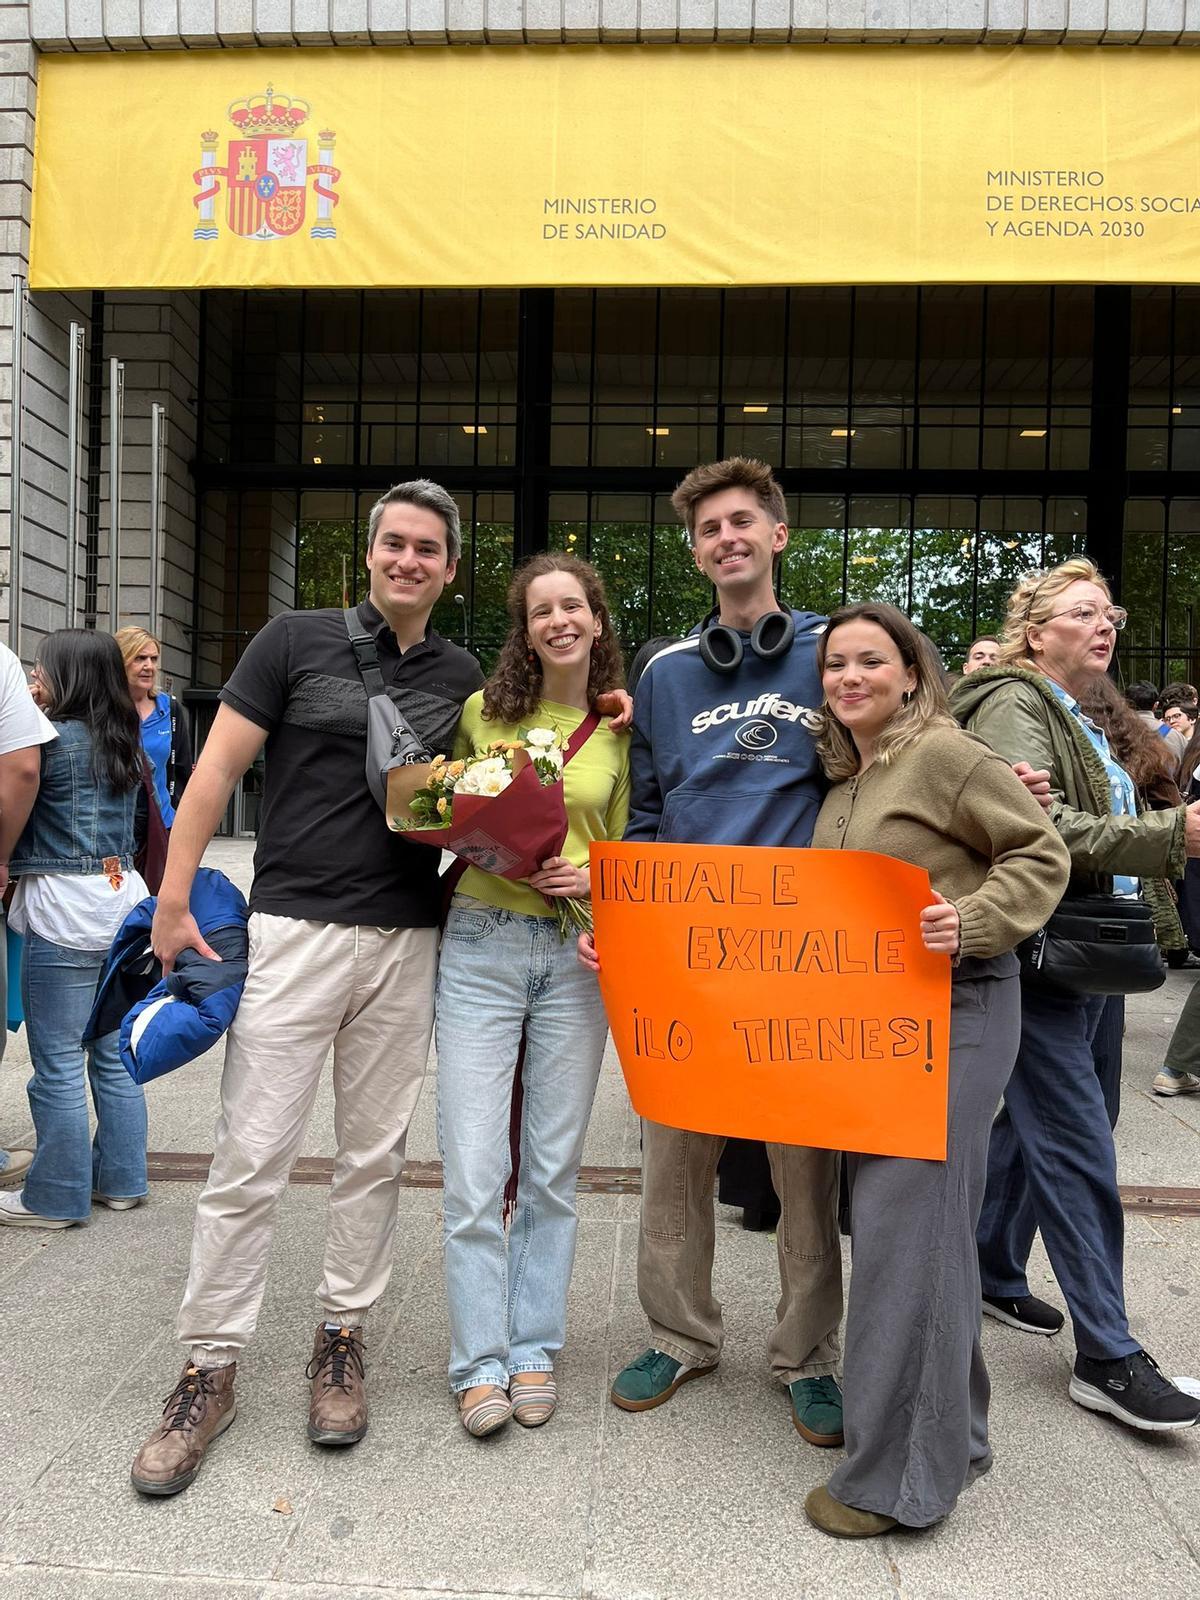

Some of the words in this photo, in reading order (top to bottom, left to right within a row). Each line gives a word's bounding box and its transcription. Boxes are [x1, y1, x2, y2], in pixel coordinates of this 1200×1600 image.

[987, 171, 1104, 187] MINISTERIO
[544, 198, 657, 214] MINISTERIO
[986, 195, 1014, 211] DE
[1021, 196, 1134, 212] DERECHOS
[1140, 196, 1200, 213] SOCIA
[543, 223, 569, 239] DE
[575, 223, 667, 239] SANIDAD
[986, 220, 999, 237] Y
[1003, 220, 1094, 237] AGENDA
[1100, 221, 1145, 237] 2030
[691, 692, 826, 734] scuffers
[600, 858, 799, 906] INHALE
[688, 926, 906, 974] EXHALE
[632, 1008, 694, 1062] ¡LO
[733, 1017, 935, 1073] TIENES!
